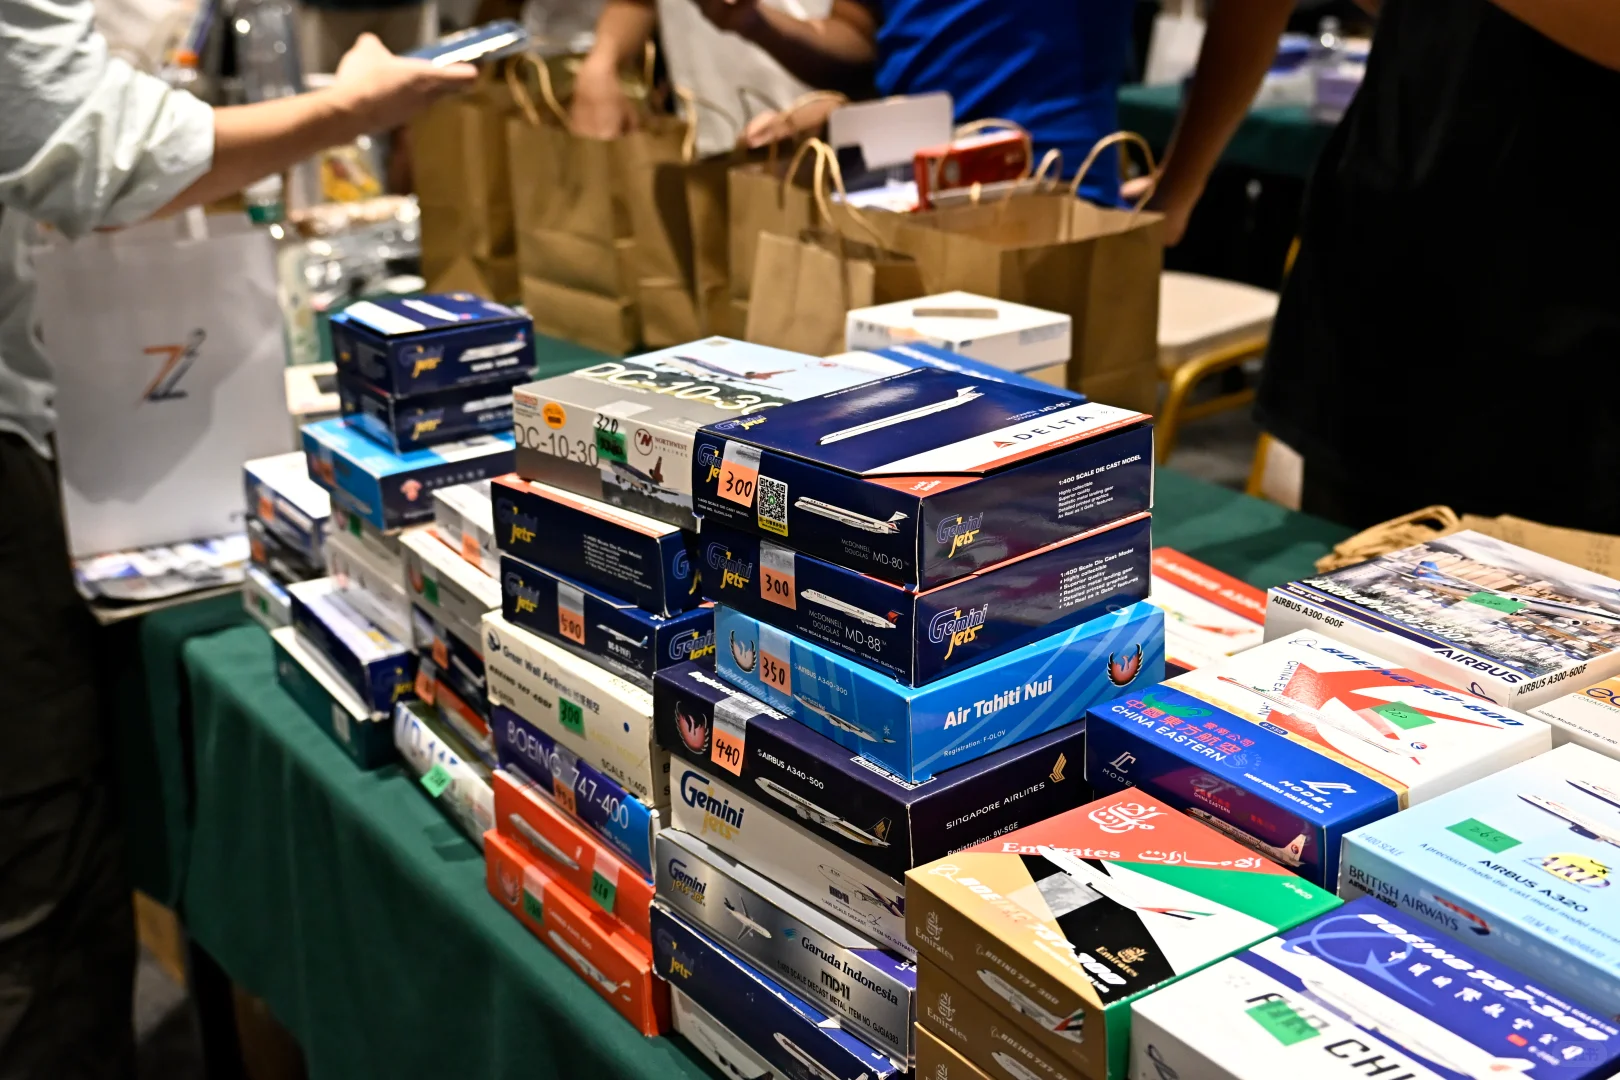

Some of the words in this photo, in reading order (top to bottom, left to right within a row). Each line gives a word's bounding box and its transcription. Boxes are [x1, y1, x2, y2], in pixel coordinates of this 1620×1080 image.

[1013, 414, 1094, 441] DELTA
[654, 436, 688, 450] NORTHWEST
[726, 471, 753, 498] 300
[1058, 476, 1075, 486] 1:400
[1075, 470, 1094, 481] SCALE
[1095, 465, 1105, 475] DIE
[1106, 460, 1121, 472] CAST
[1122, 454, 1141, 466] MODEL
[1058, 488, 1071, 496] Highly
[1072, 481, 1093, 492] collectible
[1058, 494, 1076, 502] Superior
[1077, 488, 1091, 497] quality
[1058, 497, 1075, 507] Realistic
[510, 524, 536, 544] jets
[937, 512, 983, 544] Gemini
[707, 542, 752, 574] Gemini
[841, 538, 870, 554] McDONNELL
[845, 547, 869, 560] DOUGLAS
[949, 530, 979, 559] jets
[1060, 567, 1078, 578] 1:400
[1078, 562, 1094, 572] Scale
[1094, 559, 1103, 567] Die
[1104, 555, 1117, 563] Cast
[1118, 548, 1134, 558] Model
[720, 570, 749, 589] jets
[765, 574, 789, 597] 300
[809, 609, 843, 629] McDONNELL
[929, 603, 988, 644] Gemini
[1272, 596, 1302, 612] AIRBUS
[1302, 607, 1344, 628] A300-600F
[812, 620, 840, 637] DOUGLAS
[944, 625, 983, 661] jets
[525, 659, 541, 677] Wall
[543, 671, 572, 698] Airlines
[762, 657, 785, 686] 350
[799, 664, 817, 679] AIRBUS
[817, 675, 848, 696] A340-300
[1278, 660, 1299, 681] CHINA
[1434, 648, 1525, 685] AIRBUS
[1517, 678, 1546, 696] AIRBUS
[1547, 664, 1588, 686] A300-600F
[1320, 647, 1415, 684] BOEING
[1412, 682, 1525, 726] 737-800
[943, 706, 971, 730] Air
[974, 686, 1021, 719] Tahiti
[1024, 675, 1053, 701] Nui
[1111, 705, 1154, 729] CHINA
[1155, 724, 1228, 762] EASTERN
[1126, 699, 1241, 755] 中國東方航空
[1578, 724, 1592, 734] Scale
[1601, 736, 1618, 745] 1:400
[716, 738, 740, 766] 440
[944, 739, 983, 757] Registration:
[983, 729, 1006, 743] F-OLOV
[507, 720, 562, 779] BOEING
[571, 767, 629, 829] 747-400
[601, 758, 625, 781] SCALE
[628, 776, 648, 796] 1:400
[762, 751, 785, 769] AIRBUS
[787, 765, 824, 790] A340-500
[1102, 767, 1136, 787] MODE
[680, 770, 745, 829] Gemini
[1244, 773, 1263, 783] HOBBY
[1261, 781, 1284, 794] MODELS
[1284, 792, 1301, 802] SCALE
[1278, 780, 1333, 809] MODEL
[946, 801, 1000, 830] SINGAPORE
[1003, 782, 1045, 805] AIRLINES
[1194, 792, 1208, 802] CHINA
[1209, 799, 1231, 814] EASTERN
[701, 814, 740, 840] jets
[993, 822, 1019, 838] 9V-SGE
[1378, 843, 1404, 856] SCALE
[669, 858, 707, 895] Gemini
[1425, 846, 1468, 870] precision
[1468, 867, 1493, 881] made
[1493, 879, 1508, 888] die
[1509, 886, 1533, 900] cast
[1533, 896, 1557, 913] metal
[1560, 911, 1589, 928] model
[1479, 860, 1538, 888] AIRBUS
[1538, 889, 1588, 913] A320
[1349, 879, 1374, 896] AIRBUS
[1376, 893, 1398, 908] A320
[1349, 865, 1399, 899] BRITISH
[1402, 894, 1459, 930] AIRWAYS
[915, 926, 954, 961] Emirates
[1357, 913, 1474, 971] BOEING
[669, 956, 693, 979] jets
[801, 936, 841, 970] Garuda
[842, 961, 898, 1005] Indonesia
[985, 951, 1017, 976] BOEING
[1096, 946, 1139, 977] Emirates
[790, 967, 807, 985] SCALE
[807, 978, 828, 999] DIECAST
[829, 993, 847, 1012] METAL
[848, 1006, 861, 1021] ITEM
[862, 1015, 871, 1027] NO.
[927, 1006, 968, 1042] Emirates
[1000, 1033, 1033, 1059] BOEING
